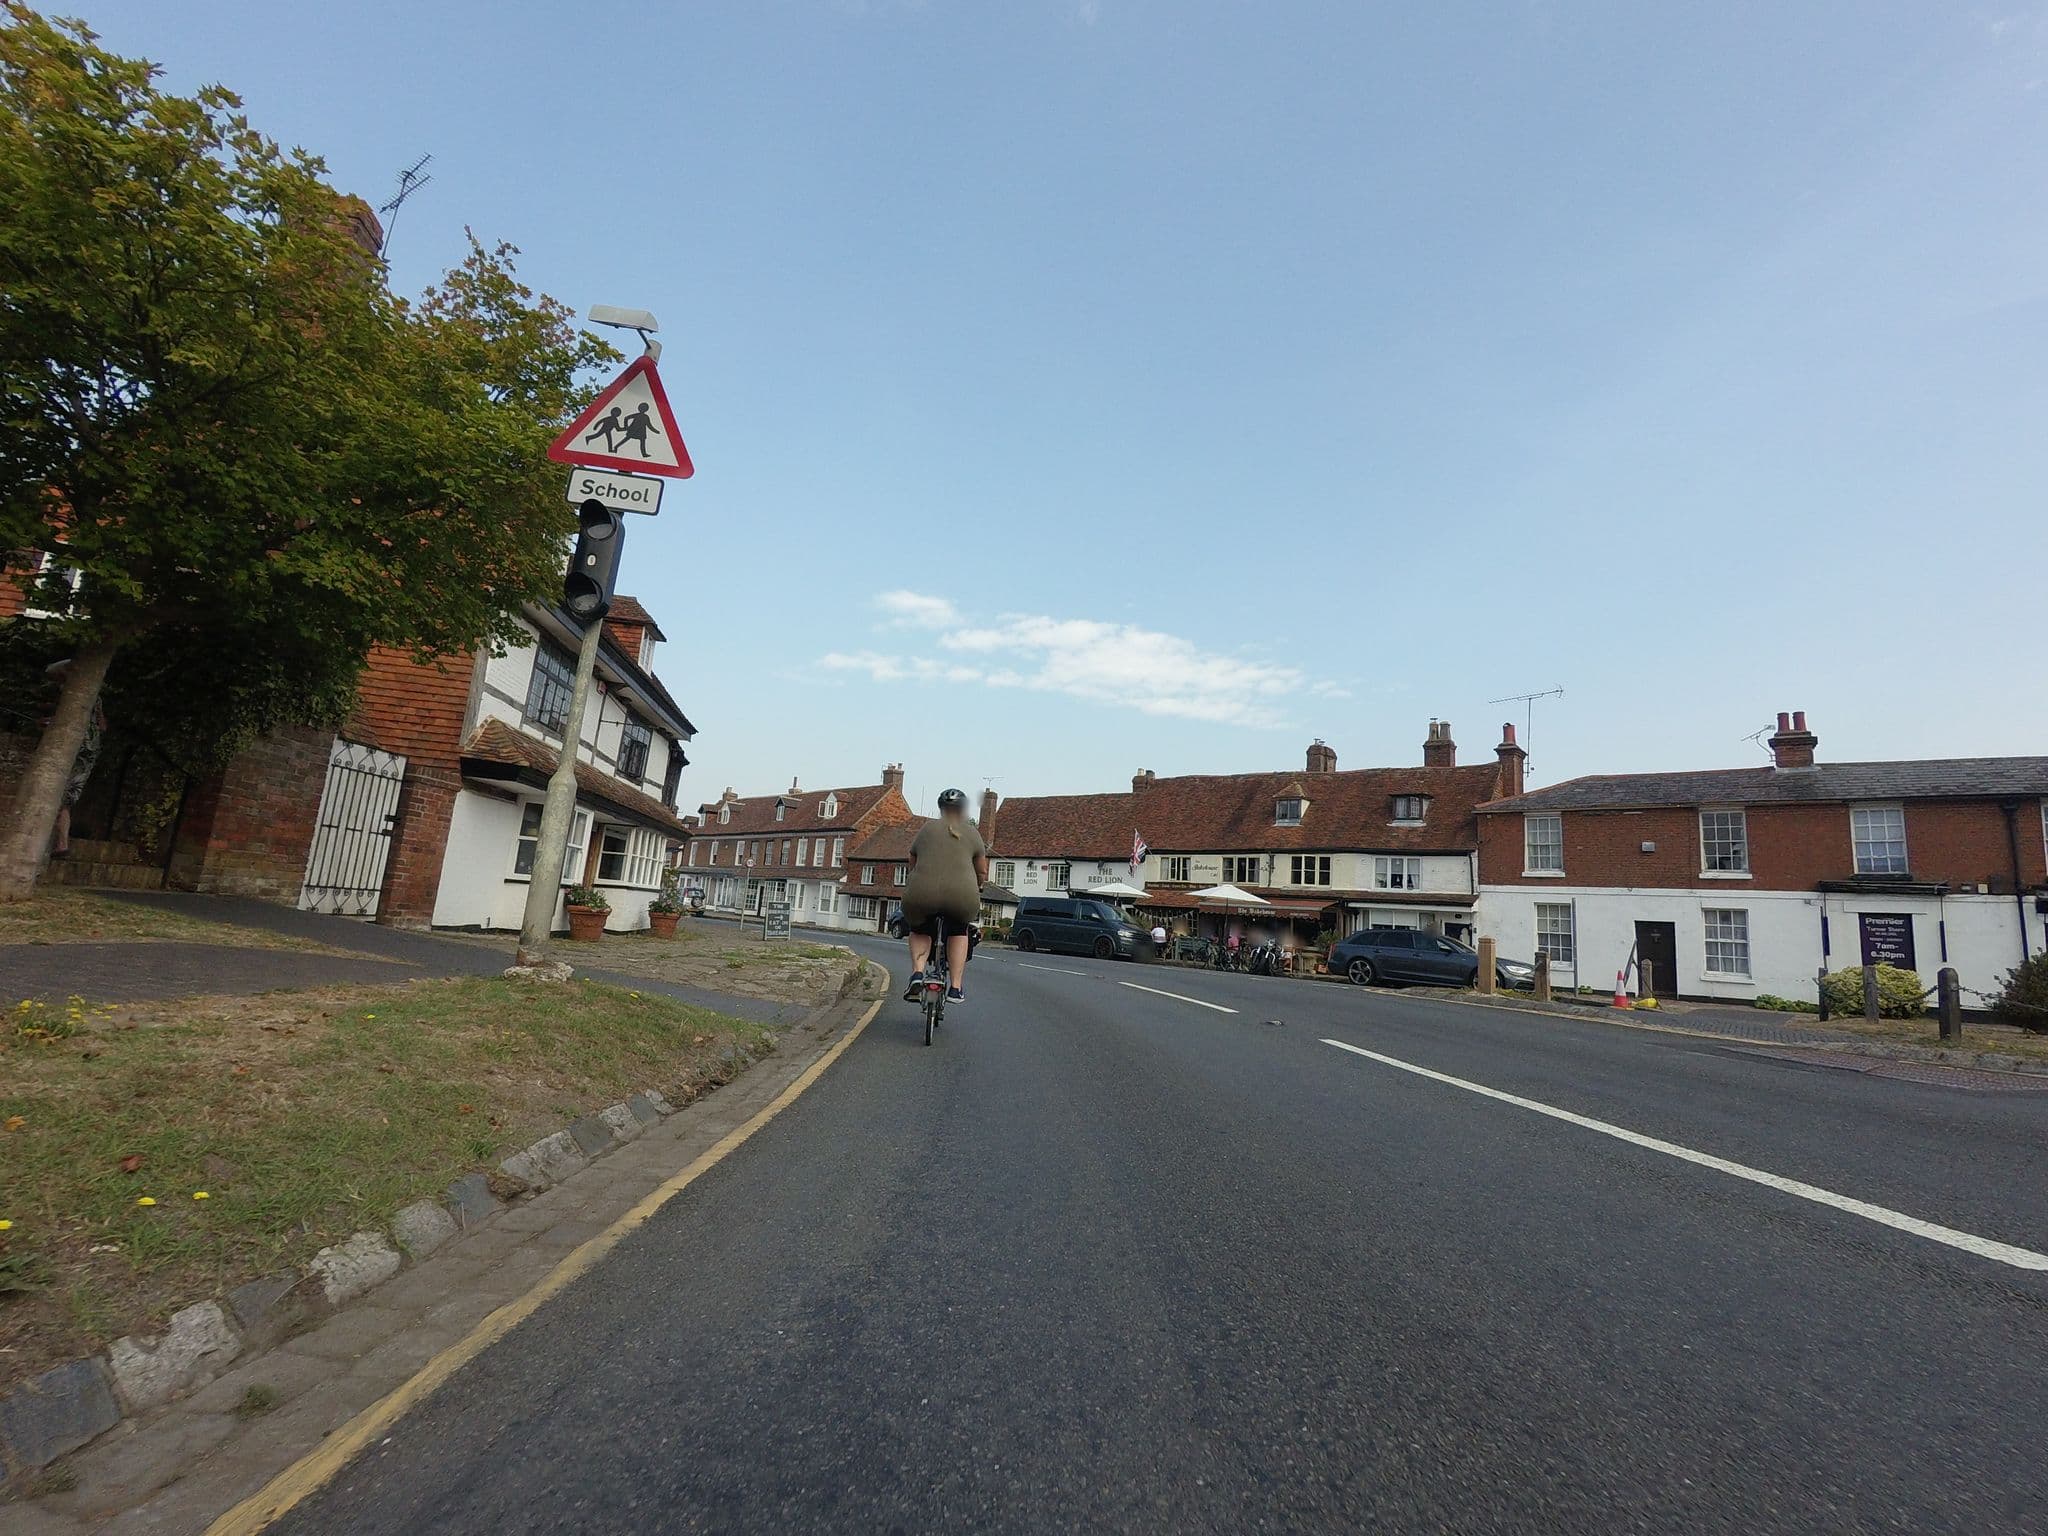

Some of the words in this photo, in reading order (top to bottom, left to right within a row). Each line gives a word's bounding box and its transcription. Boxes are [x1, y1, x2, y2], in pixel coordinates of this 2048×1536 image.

[579, 478, 650, 503] School
[1098, 867, 1113, 875] THE
[1088, 875, 1102, 883] RED
[1105, 876, 1123, 884] LION
[1865, 917, 1905, 925] Premier
